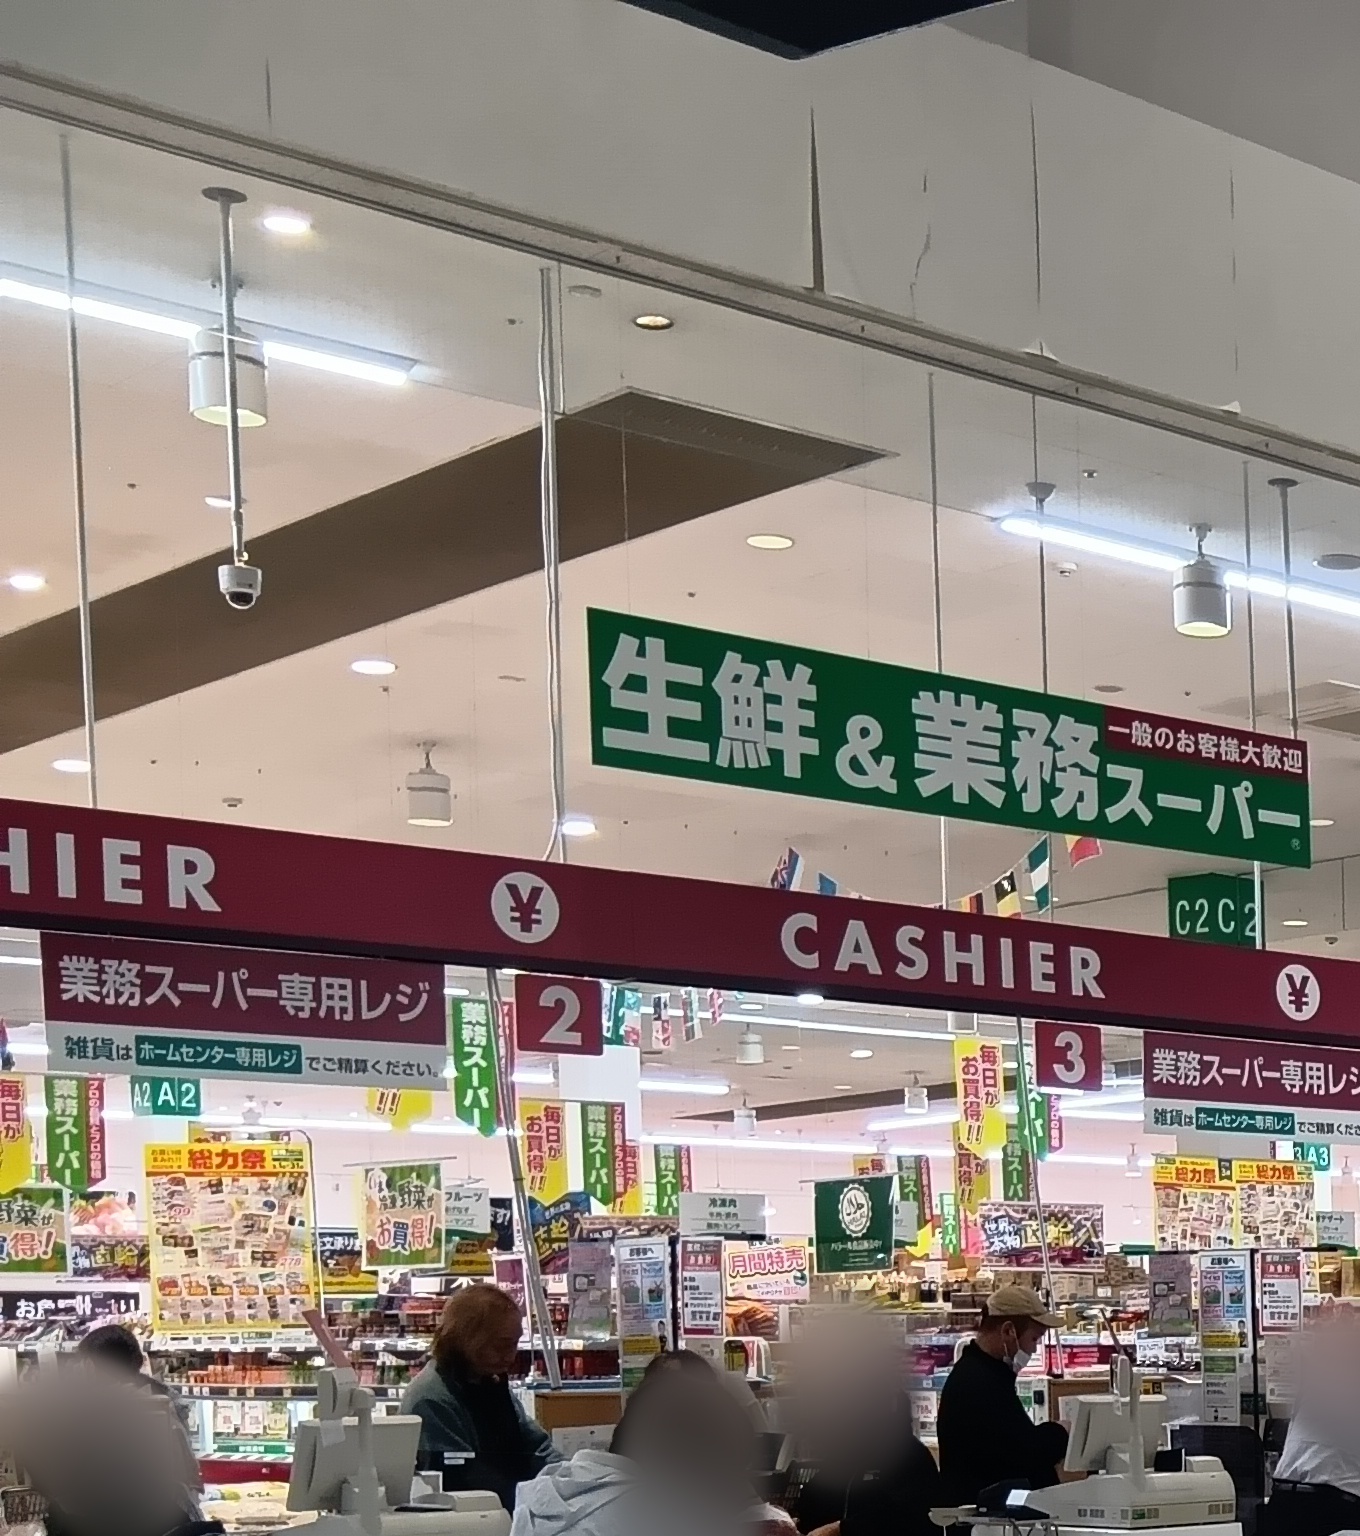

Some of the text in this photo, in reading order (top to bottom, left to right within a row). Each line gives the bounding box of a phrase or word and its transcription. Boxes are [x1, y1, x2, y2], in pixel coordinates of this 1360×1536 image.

[602, 633, 1302, 839] 生鮮&業務スーパー
[1106, 719, 1304, 774] 一般のお客様大歓迎
[1176, 899, 1210, 933] C2
[1217, 895, 1257, 936] C2
[780, 912, 1107, 999] CASHIER
[58, 955, 432, 1024] 業務スーパー専用レジ
[539, 987, 581, 1046] 2
[64, 1036, 442, 1080] 雑貨は ホームセンター専用レジ でご精算ください。
[459, 1001, 489, 1129] 業務スーパー
[1053, 1031, 1084, 1083] 3
[133, 1081, 151, 1108] A2
[158, 1081, 196, 1108] A2
[53, 1079, 80, 1186] 業務スーパー
[1154, 1109, 1194, 1127] 雑貨は
[1198, 1112, 1292, 1131] ホームセンター専用レジ
[188, 1149, 266, 1170] 総力祭
[587, 1105, 610, 1199] 業務スーパー
[1308, 1146, 1328, 1165] A3
[376, 1216, 434, 1251] お買得!
[730, 1246, 806, 1275] 月間特売
